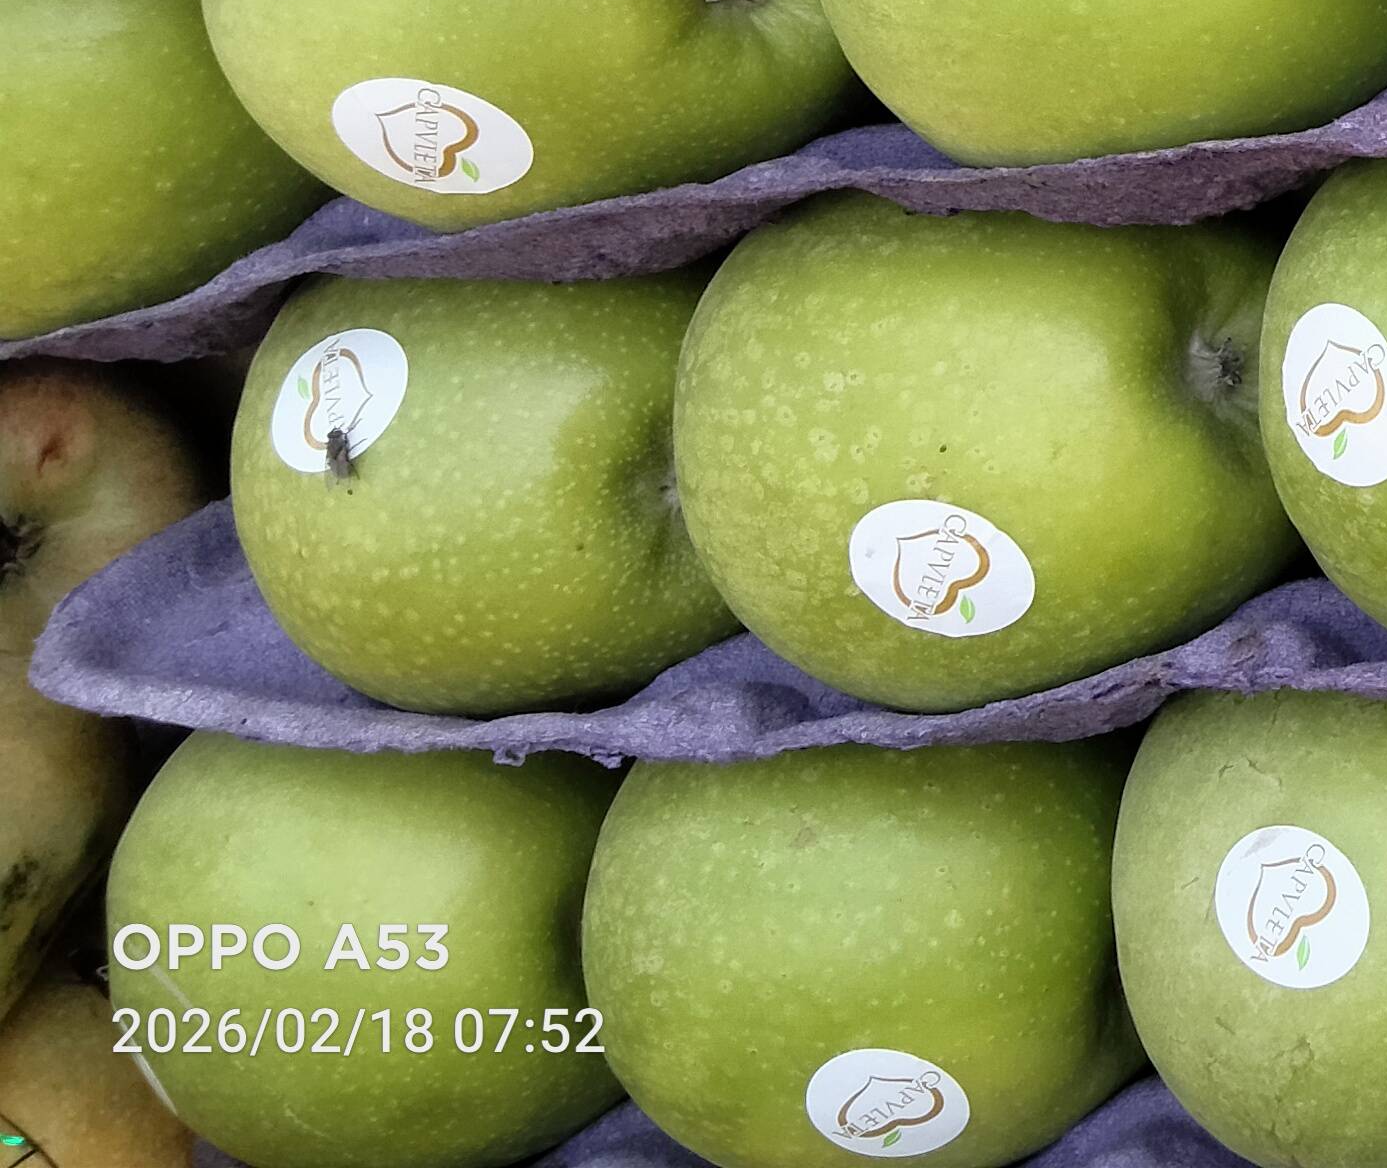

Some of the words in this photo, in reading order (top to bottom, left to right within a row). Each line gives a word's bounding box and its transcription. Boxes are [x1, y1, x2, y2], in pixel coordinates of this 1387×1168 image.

[414, 88, 443, 183] CAPVLETA
[322, 338, 345, 428] PVLETA
[1295, 343, 1386, 438] CAPVLETA
[907, 514, 967, 621] CAPVLETA
[1250, 843, 1325, 964] CAPVLETA
[832, 1071, 941, 1141] CAPVLETA
